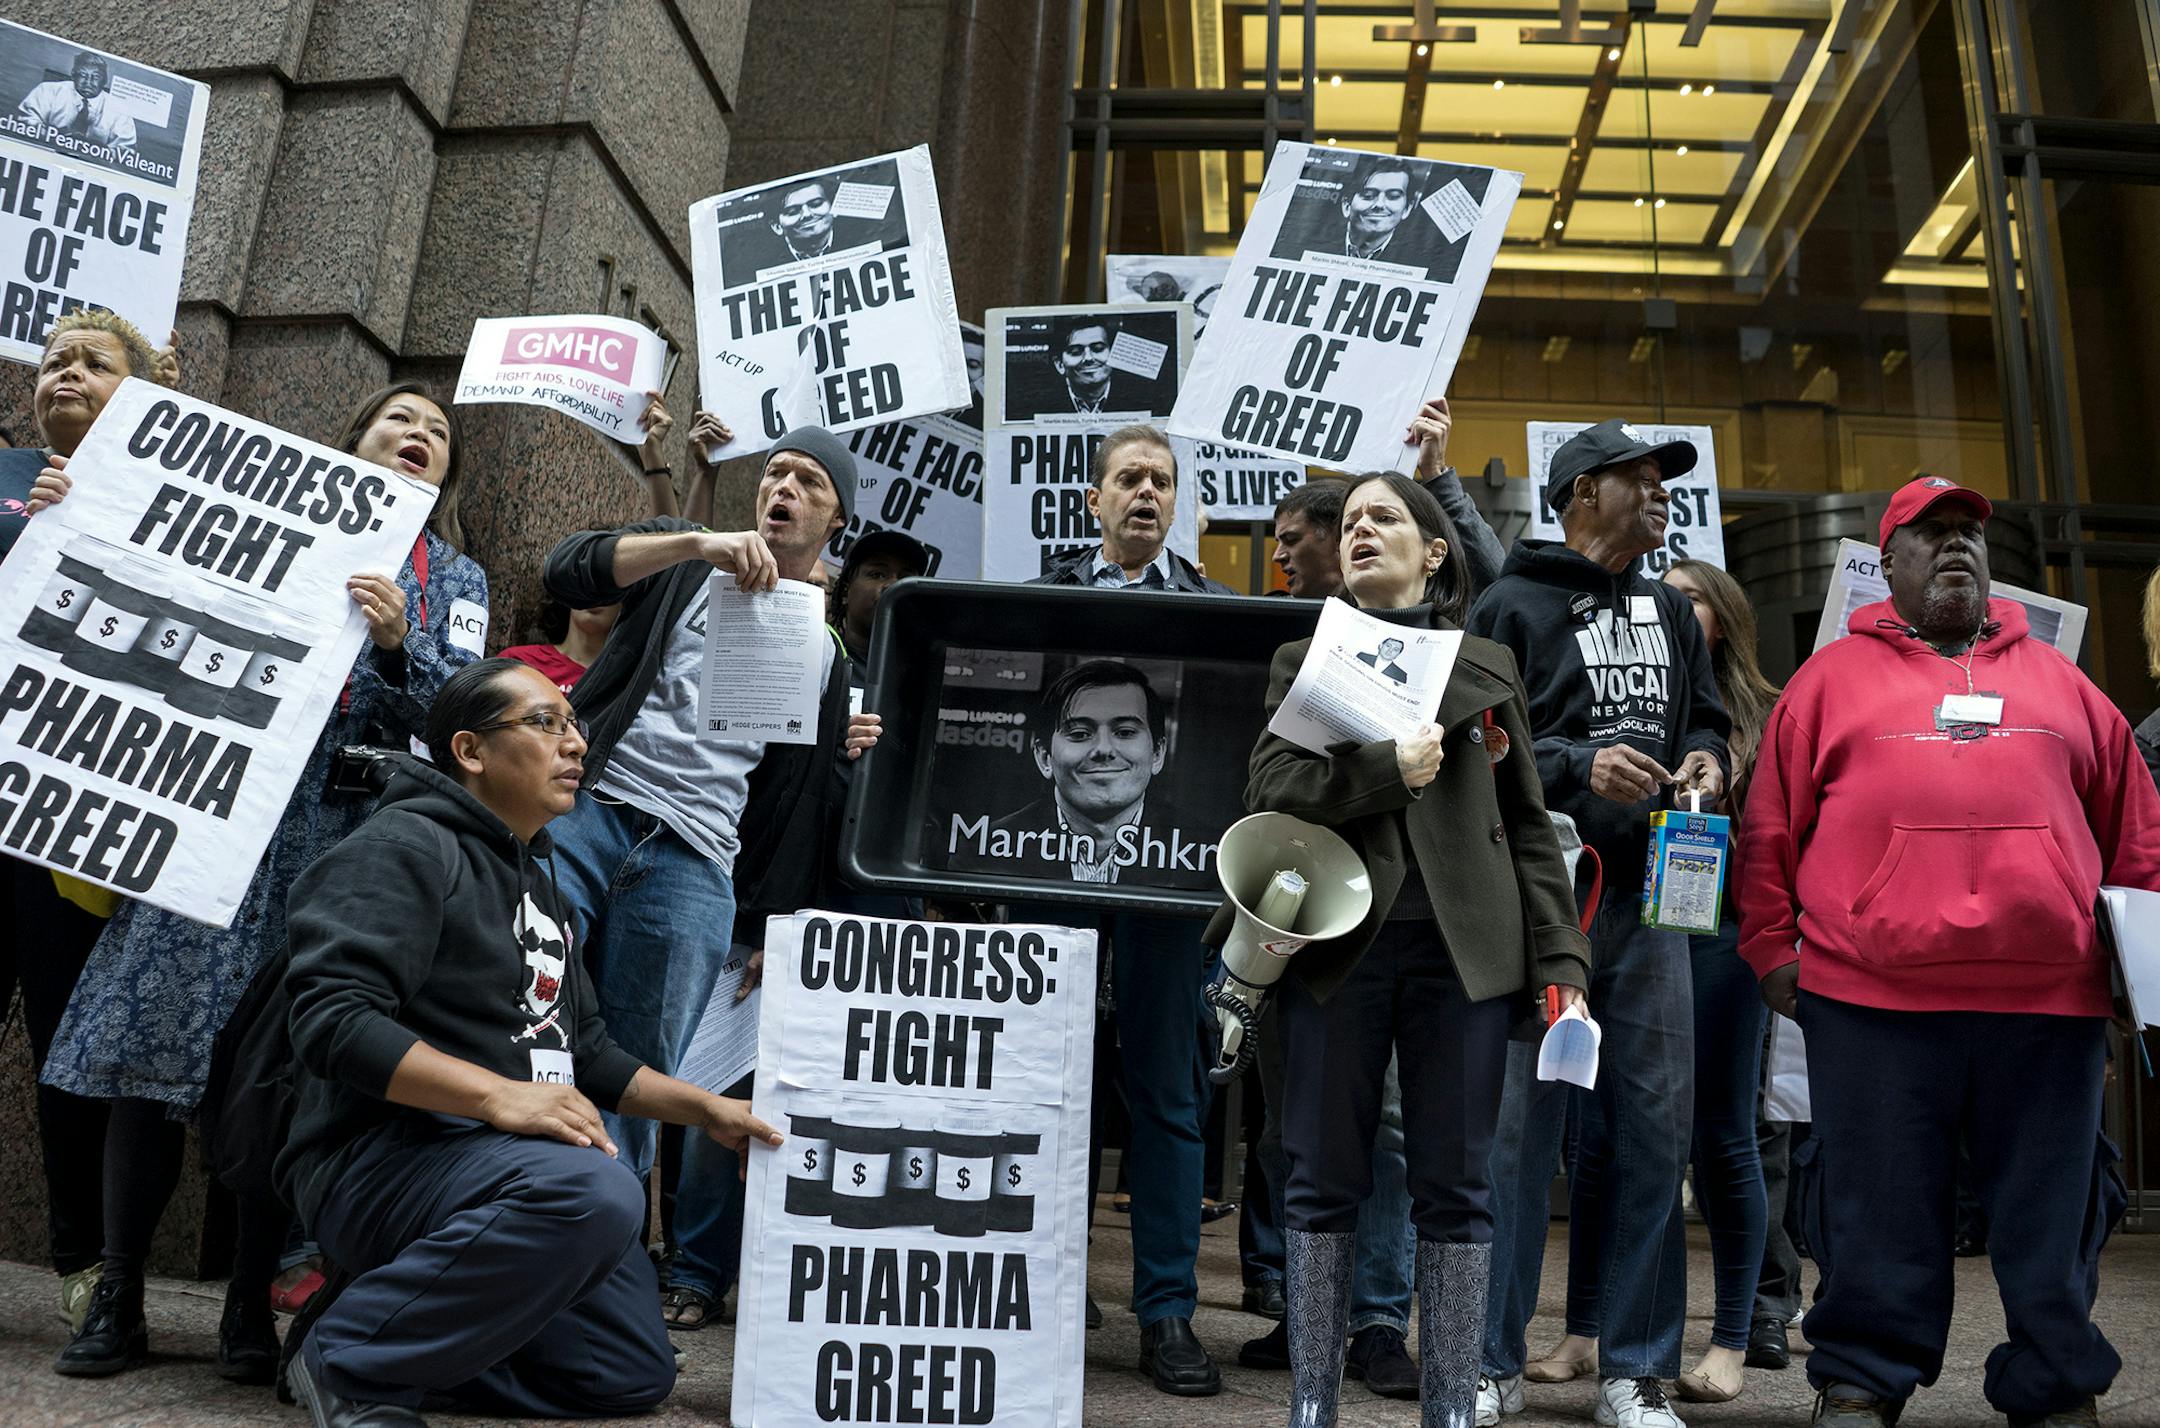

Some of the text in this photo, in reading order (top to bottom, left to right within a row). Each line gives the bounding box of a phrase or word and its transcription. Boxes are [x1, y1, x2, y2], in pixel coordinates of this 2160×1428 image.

[46, 127, 114, 163] Pearson,
[116, 147, 174, 179] Valeant
[54, 175, 167, 255] FACE
[24, 228, 84, 289] OF
[721, 254, 915, 340] THE FACE
[1243, 266, 1439, 348] THE FACE
[518, 332, 624, 371] GMHC
[716, 350, 764, 376] ACT UP
[1284, 333, 1349, 393] OF
[463, 384, 524, 397] DEMAND
[496, 371, 530, 382] FIGHT
[569, 377, 600, 396] LOVE
[601, 387, 625, 408] LIFE.
[761, 363, 904, 440] GEED
[1221, 384, 1363, 462] GREED
[128, 400, 396, 535] CONGRESS:
[860, 478, 878, 489] UP
[912, 434, 983, 504] FAC
[1225, 470, 1298, 506] LIVES
[881, 477, 933, 531] OF
[129, 483, 316, 593] FIGHT
[1846, 558, 1879, 577] ACT
[452, 614, 484, 636] ACT
[1586, 666, 1669, 702] VOCAL
[1591, 699, 1668, 717] NEW YOR
[0, 664, 253, 820] PHARMA
[752, 722, 781, 730] CLIPPERS
[0, 761, 179, 893] GREED
[948, 813, 1096, 864] Martin
[801, 916, 1059, 1006] CONGRESS:
[842, 1007, 1004, 1091] FIGHT
[787, 1243, 1032, 1331] PHARMA
[814, 1340, 997, 1425] GREED
